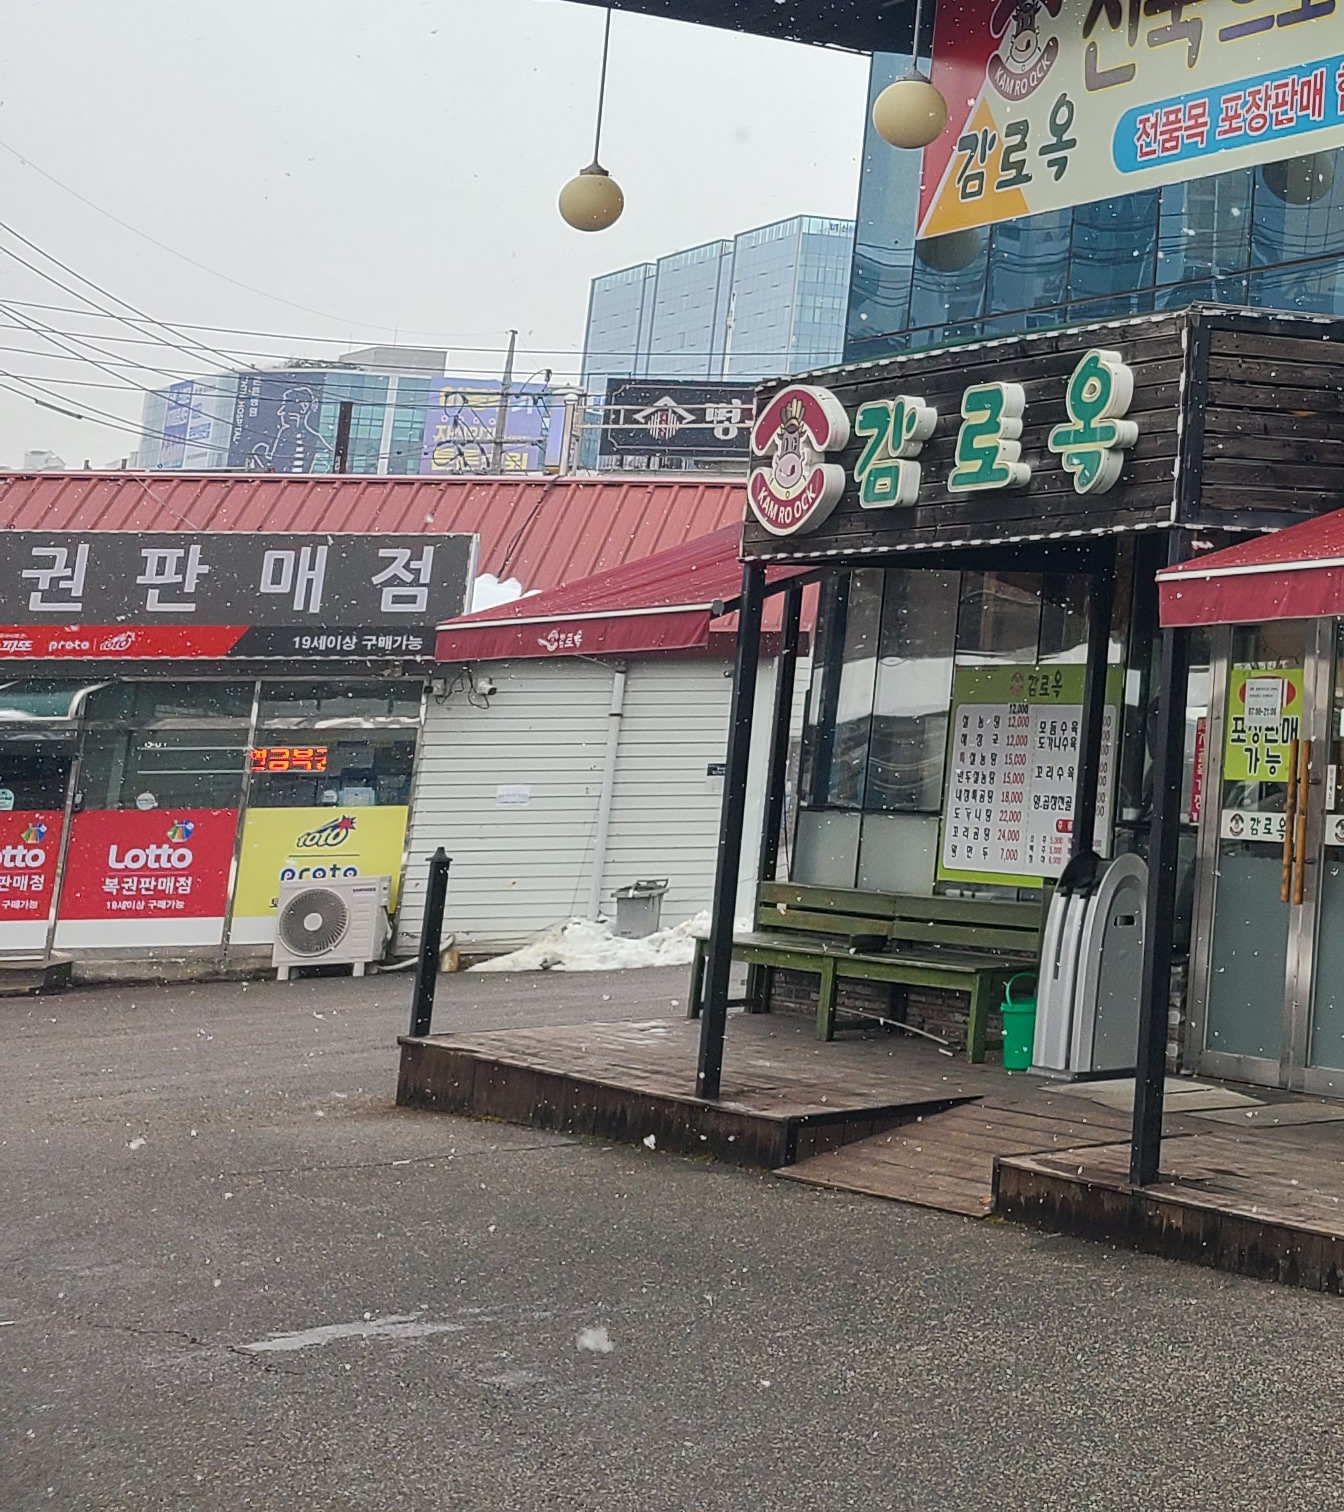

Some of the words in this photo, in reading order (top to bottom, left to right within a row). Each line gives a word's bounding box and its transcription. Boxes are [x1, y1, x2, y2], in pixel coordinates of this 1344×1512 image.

[994, 65, 1014, 94] KAM
[1014, 78, 1028, 96] RO
[1134, 98, 1209, 161] 전품목
[1217, 68, 1326, 138] 포장판매
[956, 93, 1077, 201] 감로옥
[854, 348, 1138, 509] 감로옥
[758, 487, 777, 520] KAM
[778, 506, 793, 524] RO
[794, 487, 817, 518] OCK
[48, 640, 90, 652] proto
[292, 635, 358, 650] 19세이상
[361, 635, 423, 650] 구매가능
[1029, 669, 1063, 698] 감로옥
[1008, 716, 1029, 728] 12,000
[1006, 734, 1028, 746] 12,000
[1004, 754, 1027, 766] 15,000
[1244, 747, 1281, 776] 가능
[1003, 772, 1025, 785] 15,000
[1001, 791, 1023, 804] 18,000
[999, 810, 1022, 823] 22,000
[997, 828, 1020, 842] 24,000
[108, 844, 193, 869] Lotto
[1000, 847, 1018, 862] 7,000
[102, 876, 192, 895] 복권판매점
